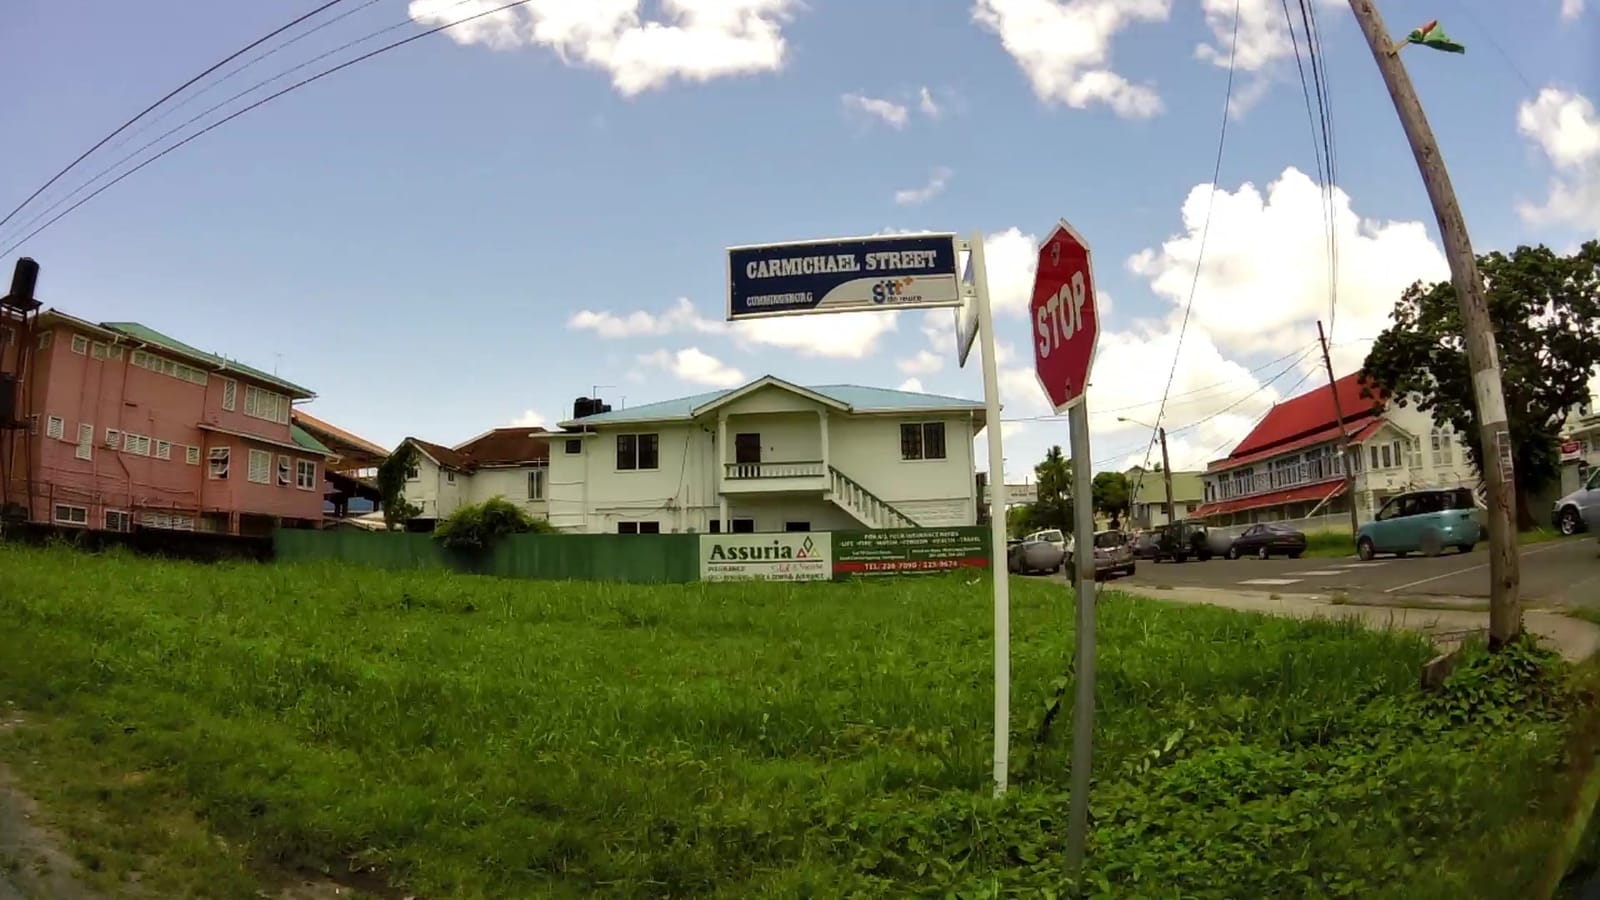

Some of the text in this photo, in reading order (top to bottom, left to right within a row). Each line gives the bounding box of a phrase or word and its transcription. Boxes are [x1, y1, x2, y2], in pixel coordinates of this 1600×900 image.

[746, 250, 937, 279] CARMICHAEL STREET
[1037, 270, 1086, 358] STOP
[710, 539, 792, 560] Assuria
